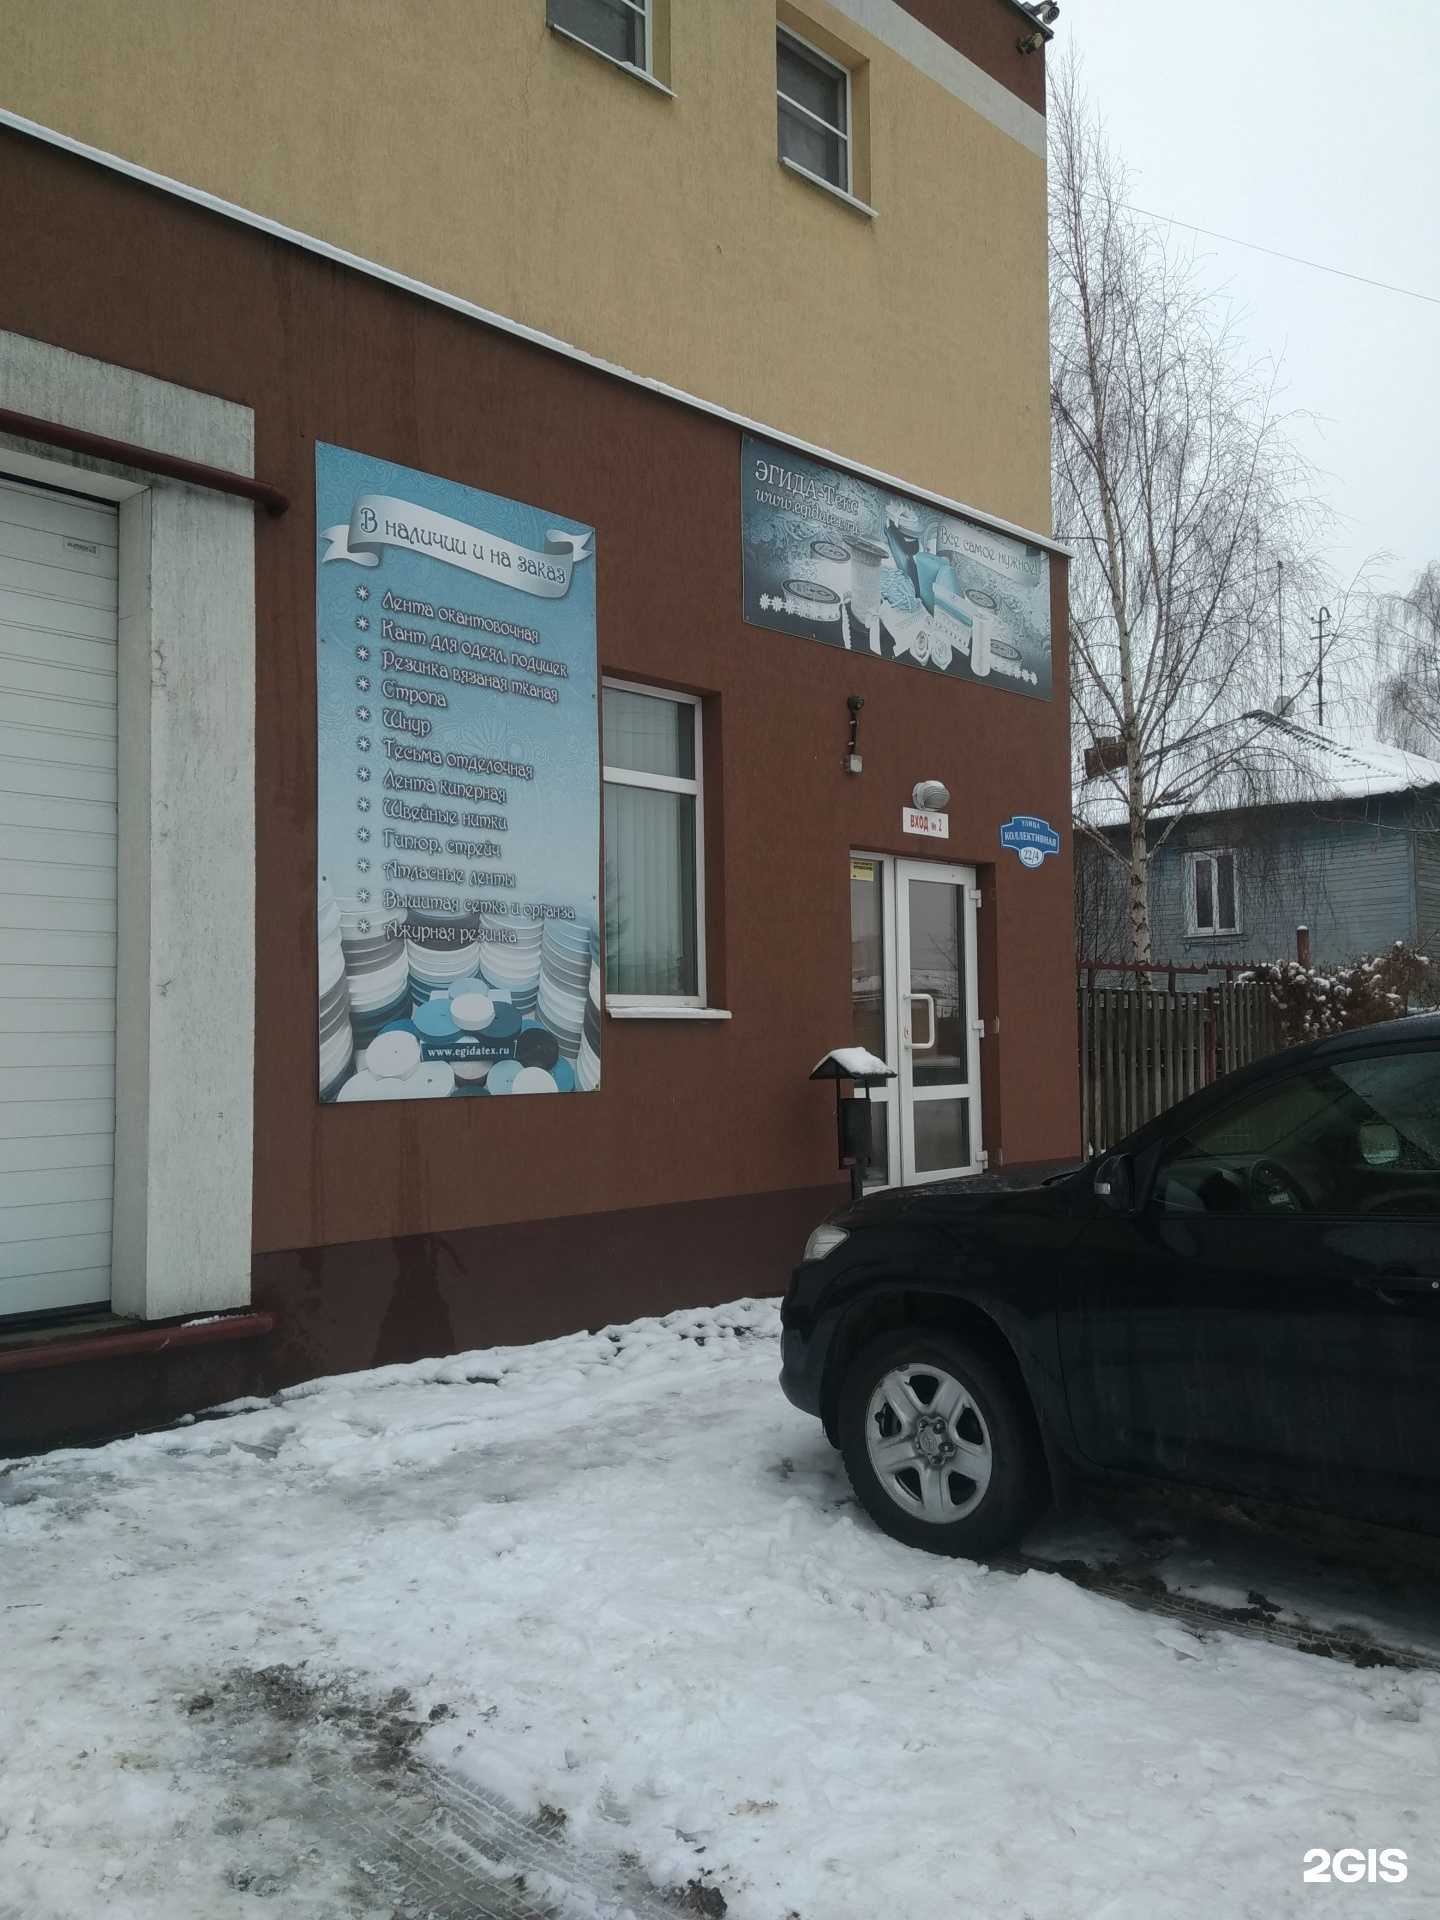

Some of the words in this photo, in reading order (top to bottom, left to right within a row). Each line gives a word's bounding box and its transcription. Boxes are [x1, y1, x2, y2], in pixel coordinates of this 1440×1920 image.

[360, 507, 378, 534] В
[385, 520, 466, 554] наличии
[472, 543, 484, 560] и
[490, 549, 512, 568] на
[517, 556, 566, 584] заказ
[963, 540, 995, 560] самое
[382, 592, 434, 619] Лента
[439, 608, 539, 643] окантовочная
[381, 620, 427, 645] Кант
[430, 635, 458, 653] для
[511, 653, 568, 677] подушек
[383, 650, 449, 679] Резинка
[452, 669, 508, 692] вязаная
[512, 682, 558, 703] тканая
[382, 680, 448, 708] Стропа
[383, 708, 431, 736] Шнур
[383, 738, 442, 766] Тесьма
[447, 753, 534, 779] отделочная
[383, 770, 436, 795] Лента
[440, 780, 507, 802] киперная
[383, 799, 458, 825] Швейные
[462, 812, 508, 830] нитки
[911, 815, 928, 832] ВХОД
[446, 838, 501, 858] стрейч
[383, 861, 465, 885] Атласные
[468, 870, 516, 887] ленты
[383, 892, 460, 913] Вышитая
[464, 897, 508, 915] сетка
[511, 903, 521, 917] и
[524, 903, 575, 921] органза
[383, 922, 456, 943] Ажурная
[460, 928, 517, 946] резинка
[427, 1045, 510, 1058] www.egidatex.ru
